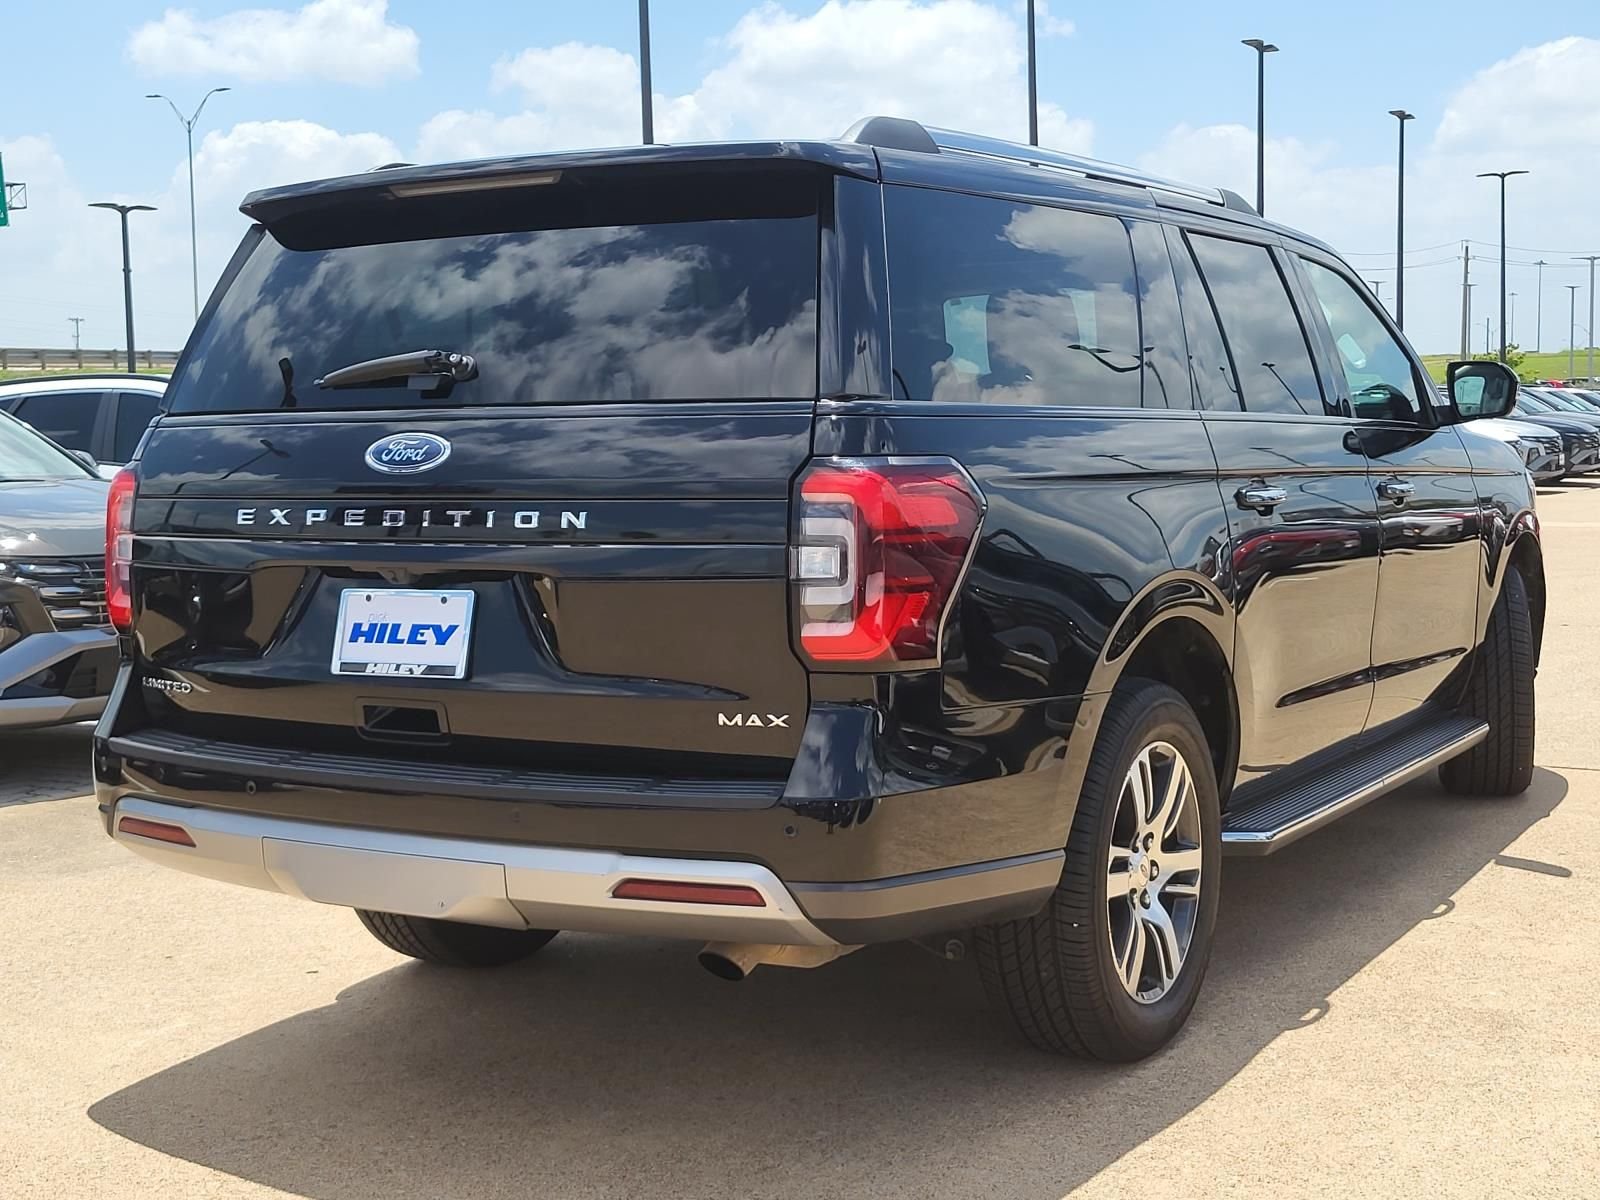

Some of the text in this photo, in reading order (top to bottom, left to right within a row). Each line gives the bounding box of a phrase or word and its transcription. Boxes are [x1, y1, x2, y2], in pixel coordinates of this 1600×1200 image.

[381, 439, 430, 461] Ford
[236, 508, 587, 529] EXPEDITION
[349, 622, 460, 645] HILEY
[365, 663, 428, 675] HILEY
[142, 676, 192, 693] LIMITED
[718, 712, 790, 728] MAX
